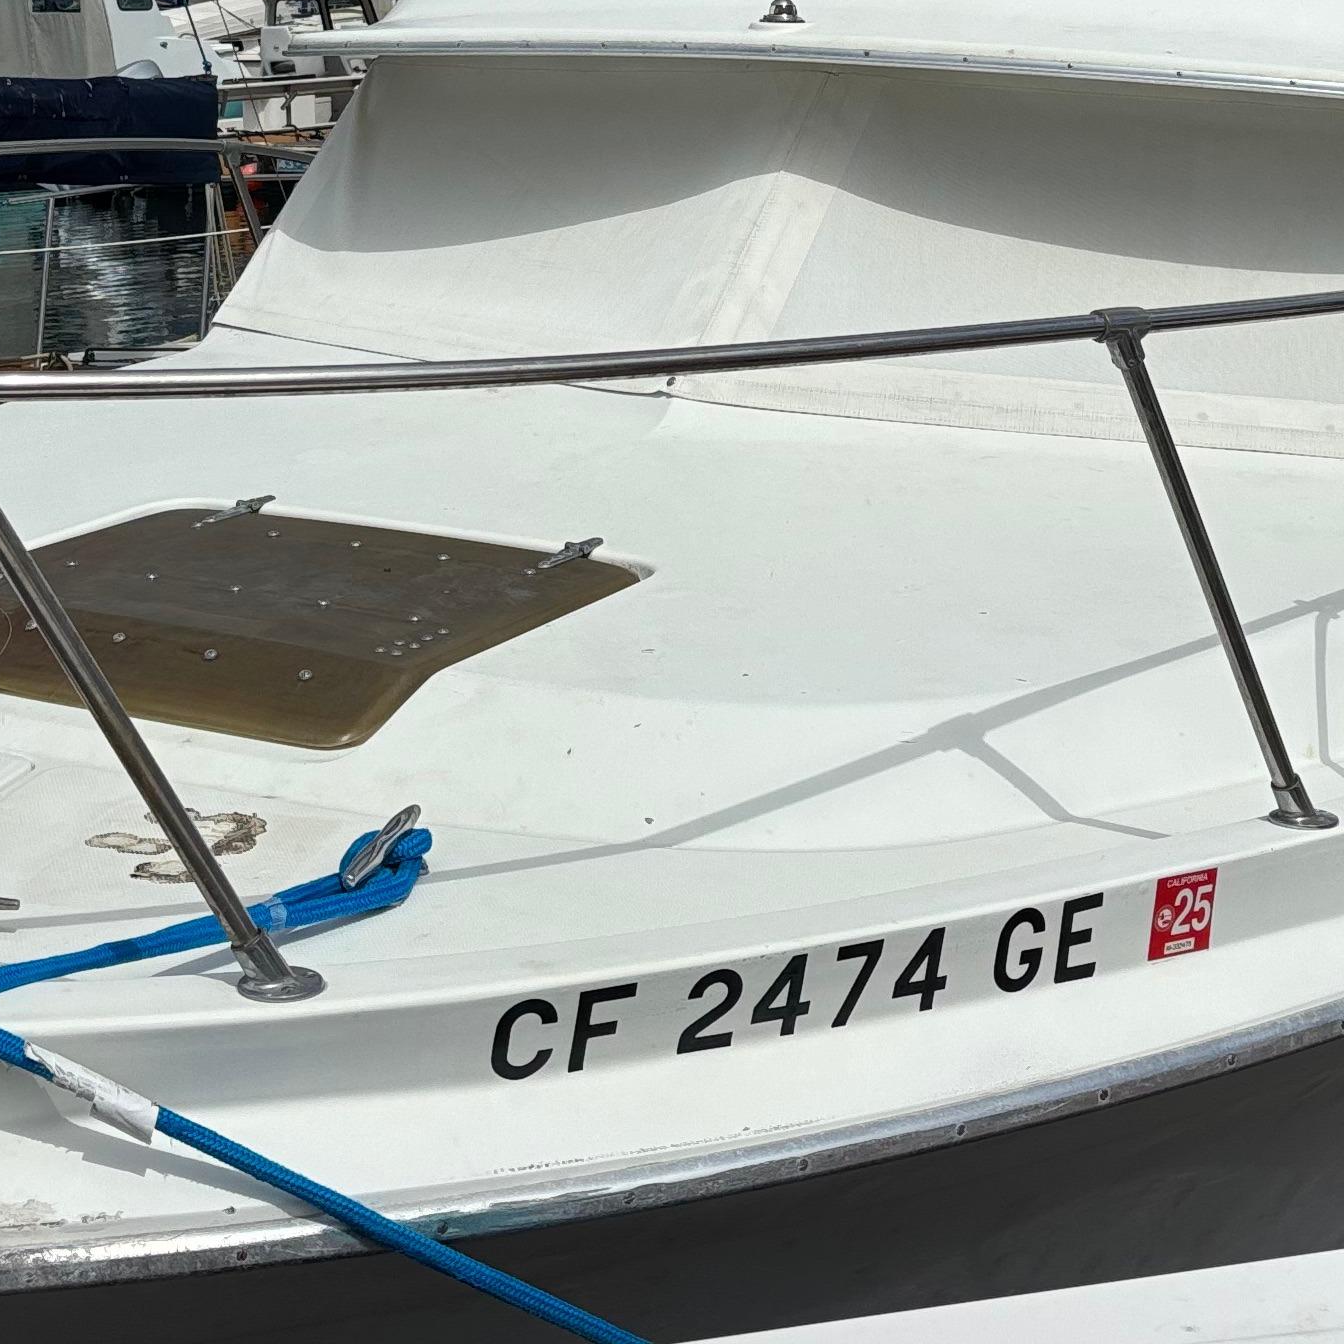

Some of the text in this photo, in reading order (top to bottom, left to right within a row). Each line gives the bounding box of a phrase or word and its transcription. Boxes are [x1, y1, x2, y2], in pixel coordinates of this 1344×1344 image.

[1166, 872, 1208, 888] CALIFORNIA
[1170, 883, 1214, 936] 25
[490, 891, 1104, 1080] CF 2474 GE
